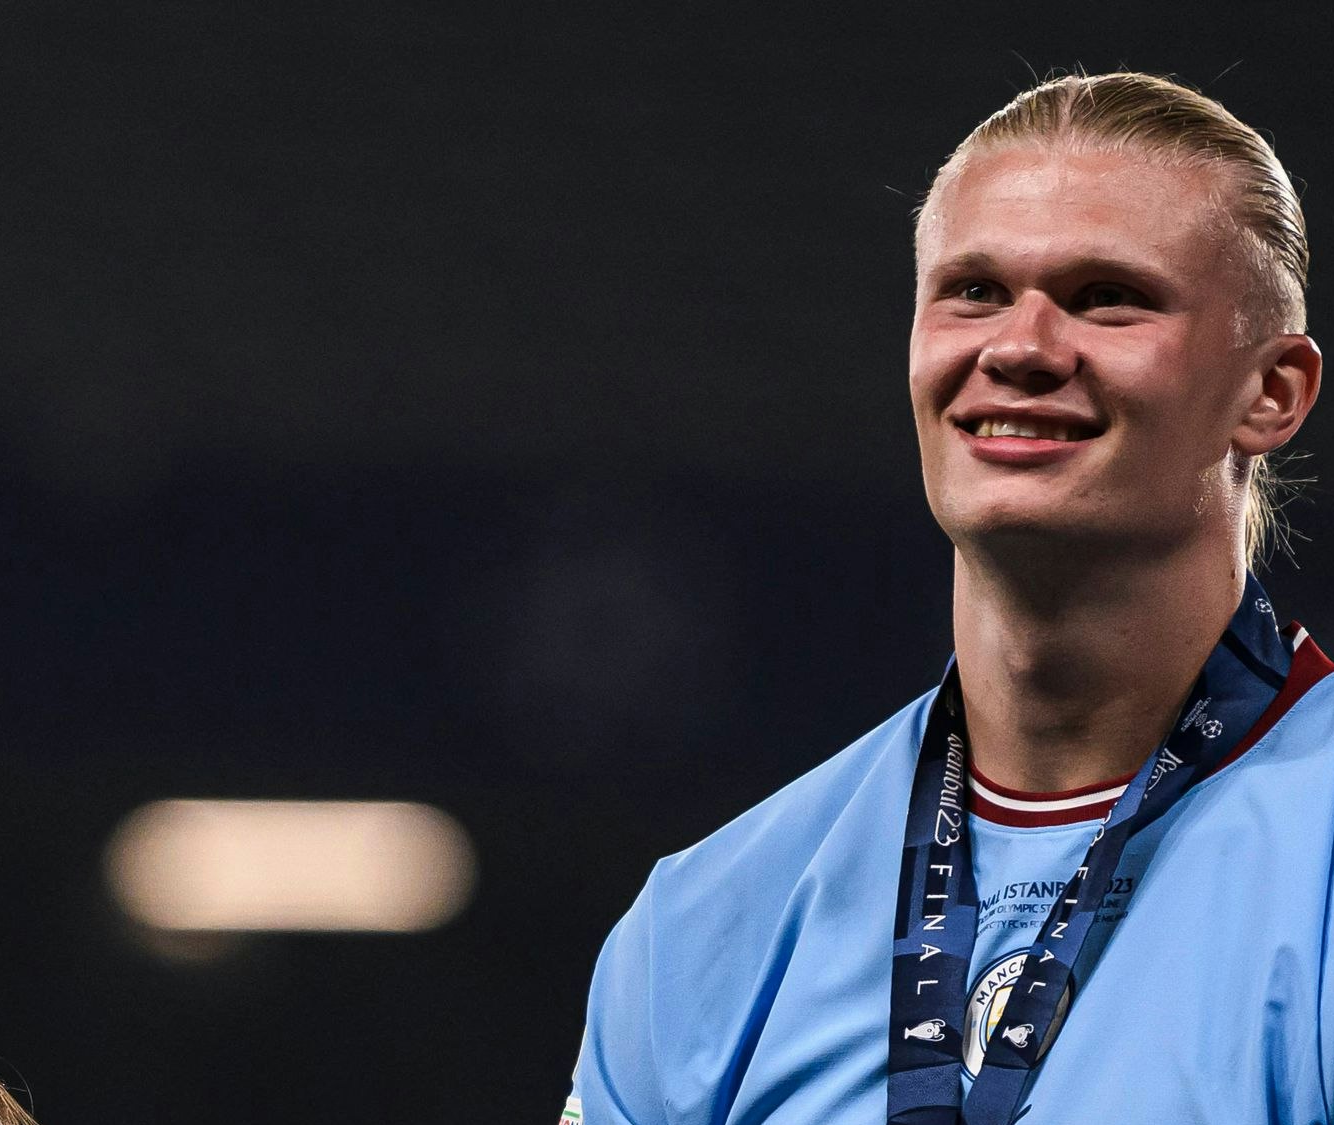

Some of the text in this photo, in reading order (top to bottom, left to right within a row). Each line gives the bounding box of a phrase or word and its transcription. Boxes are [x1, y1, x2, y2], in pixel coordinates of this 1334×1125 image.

[917, 864, 953, 995] FINAL
[1003, 881, 1067, 900] ISTAN
[1028, 866, 1089, 994] FINAL
